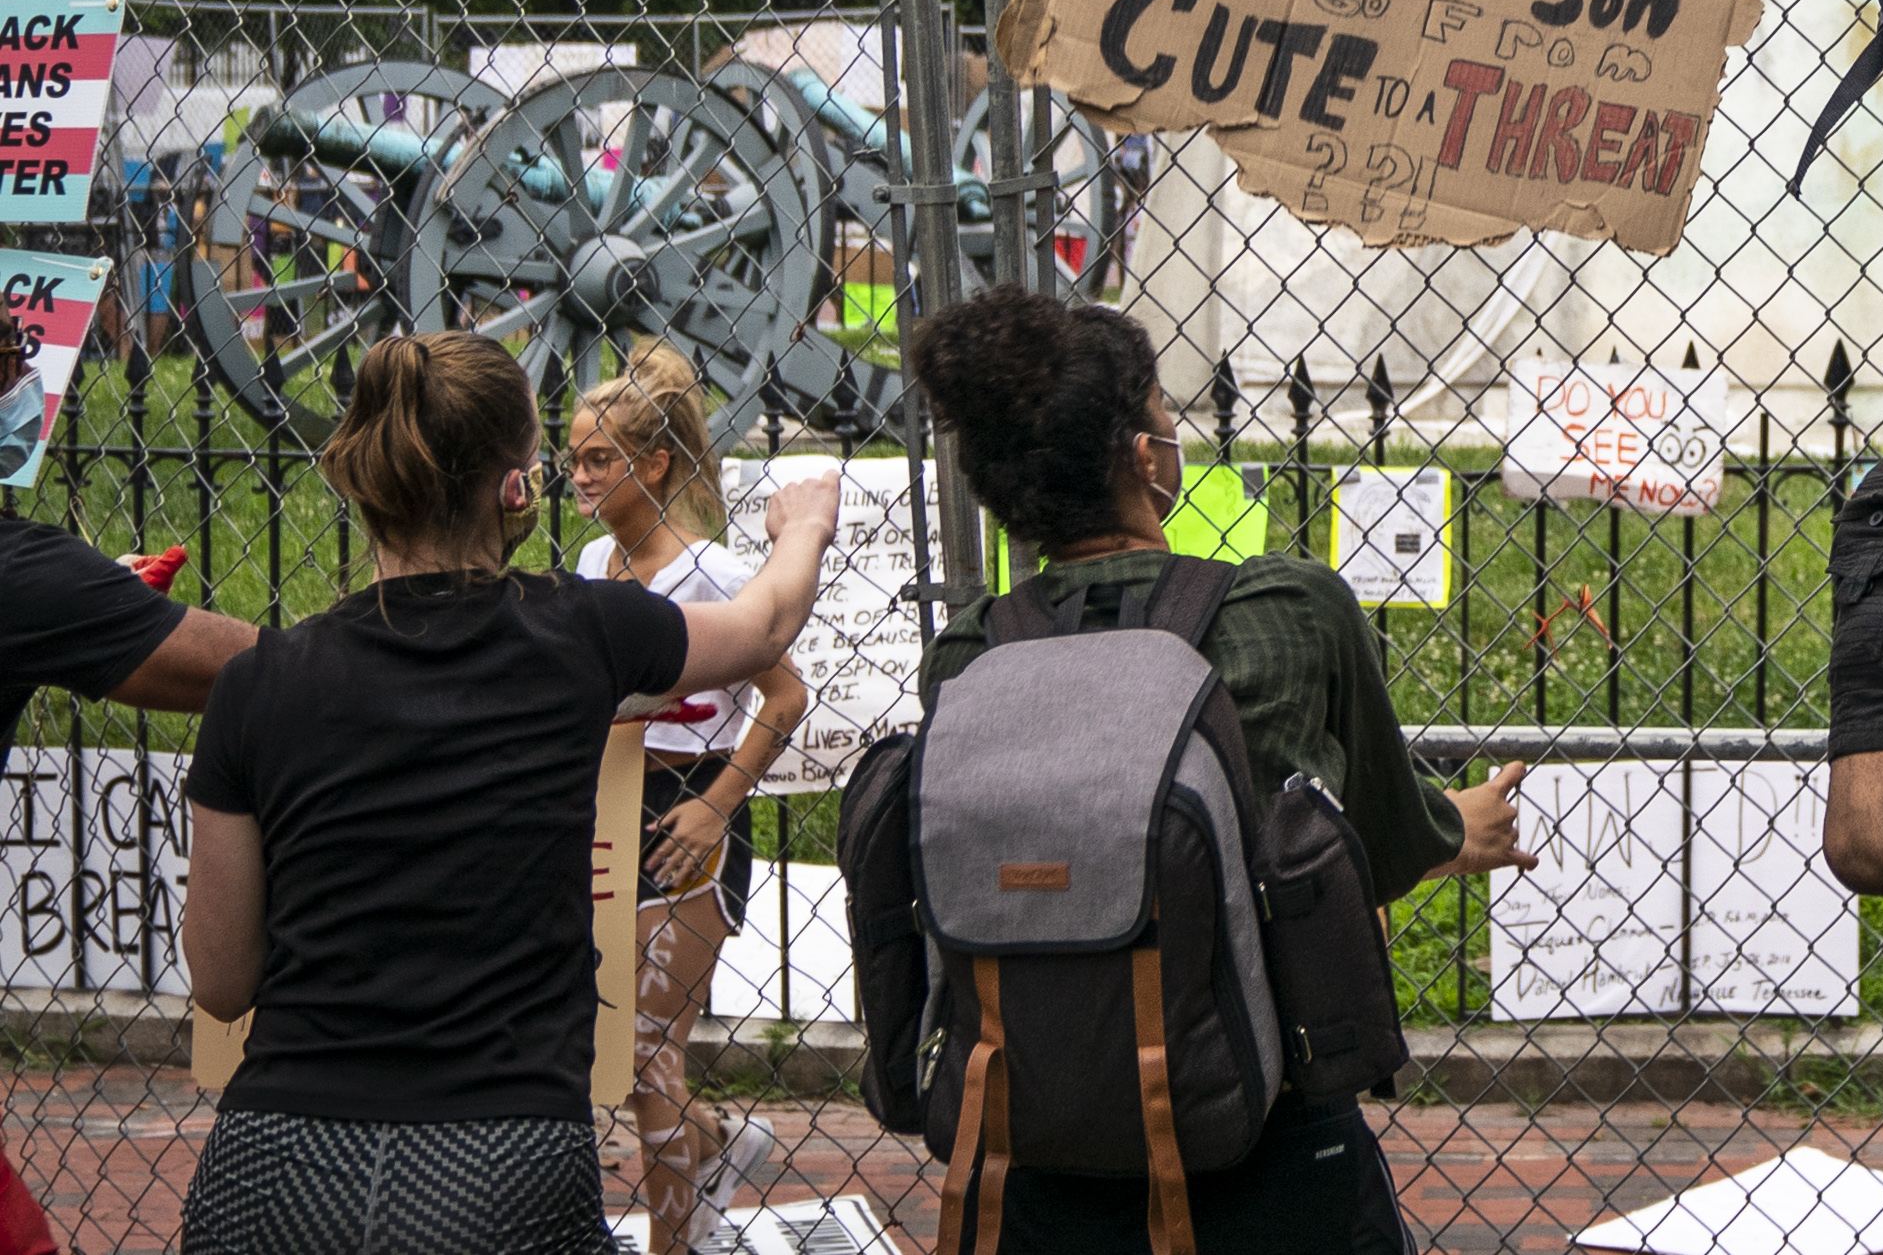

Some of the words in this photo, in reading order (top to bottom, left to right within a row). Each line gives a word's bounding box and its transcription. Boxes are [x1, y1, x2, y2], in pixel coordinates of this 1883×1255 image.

[0, 111, 53, 147] ES
[1375, 76, 1411, 118] TO
[1408, 92, 1435, 125] A
[1439, 59, 1700, 196] THREAT
[1536, 375, 1590, 417] DO
[1608, 383, 1667, 420] YOU
[1560, 423, 1637, 465] SEE
[1590, 472, 1631, 499] ME
[835, 658, 875, 678] SPY
[802, 720, 857, 751] LIVES
[2, 773, 61, 847] I
[102, 775, 188, 858] CA
[21, 870, 188, 965] BREA
